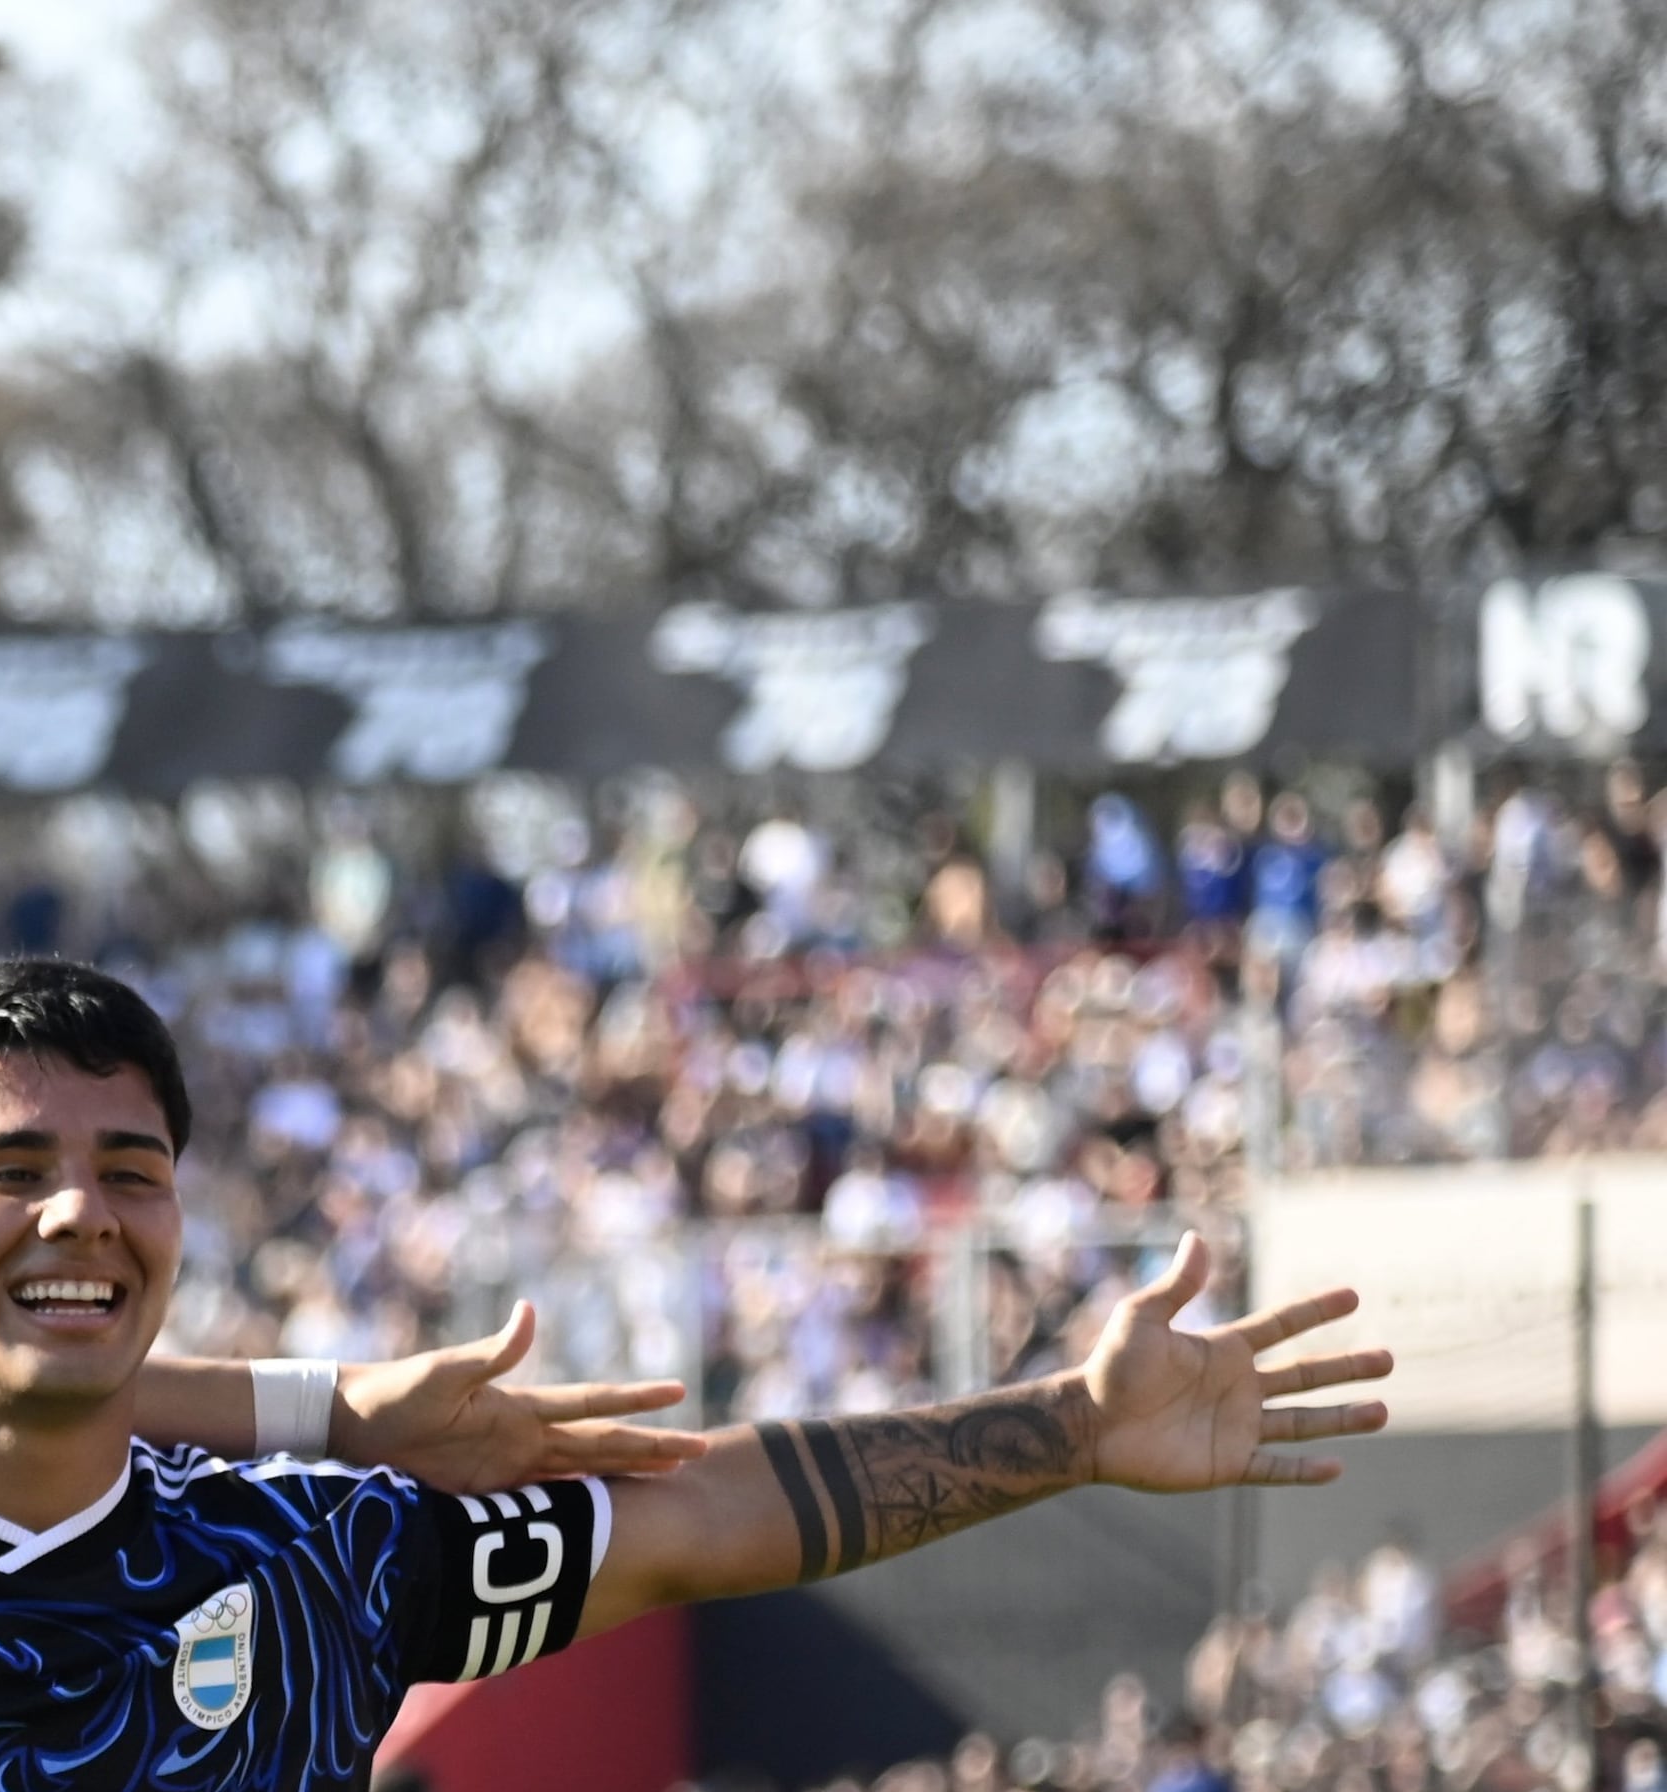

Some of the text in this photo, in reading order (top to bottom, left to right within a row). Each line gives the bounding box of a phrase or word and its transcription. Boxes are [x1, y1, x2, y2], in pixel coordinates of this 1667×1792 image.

[177, 1633, 247, 1724] COMITE OLIMPICO ARGENTINO
